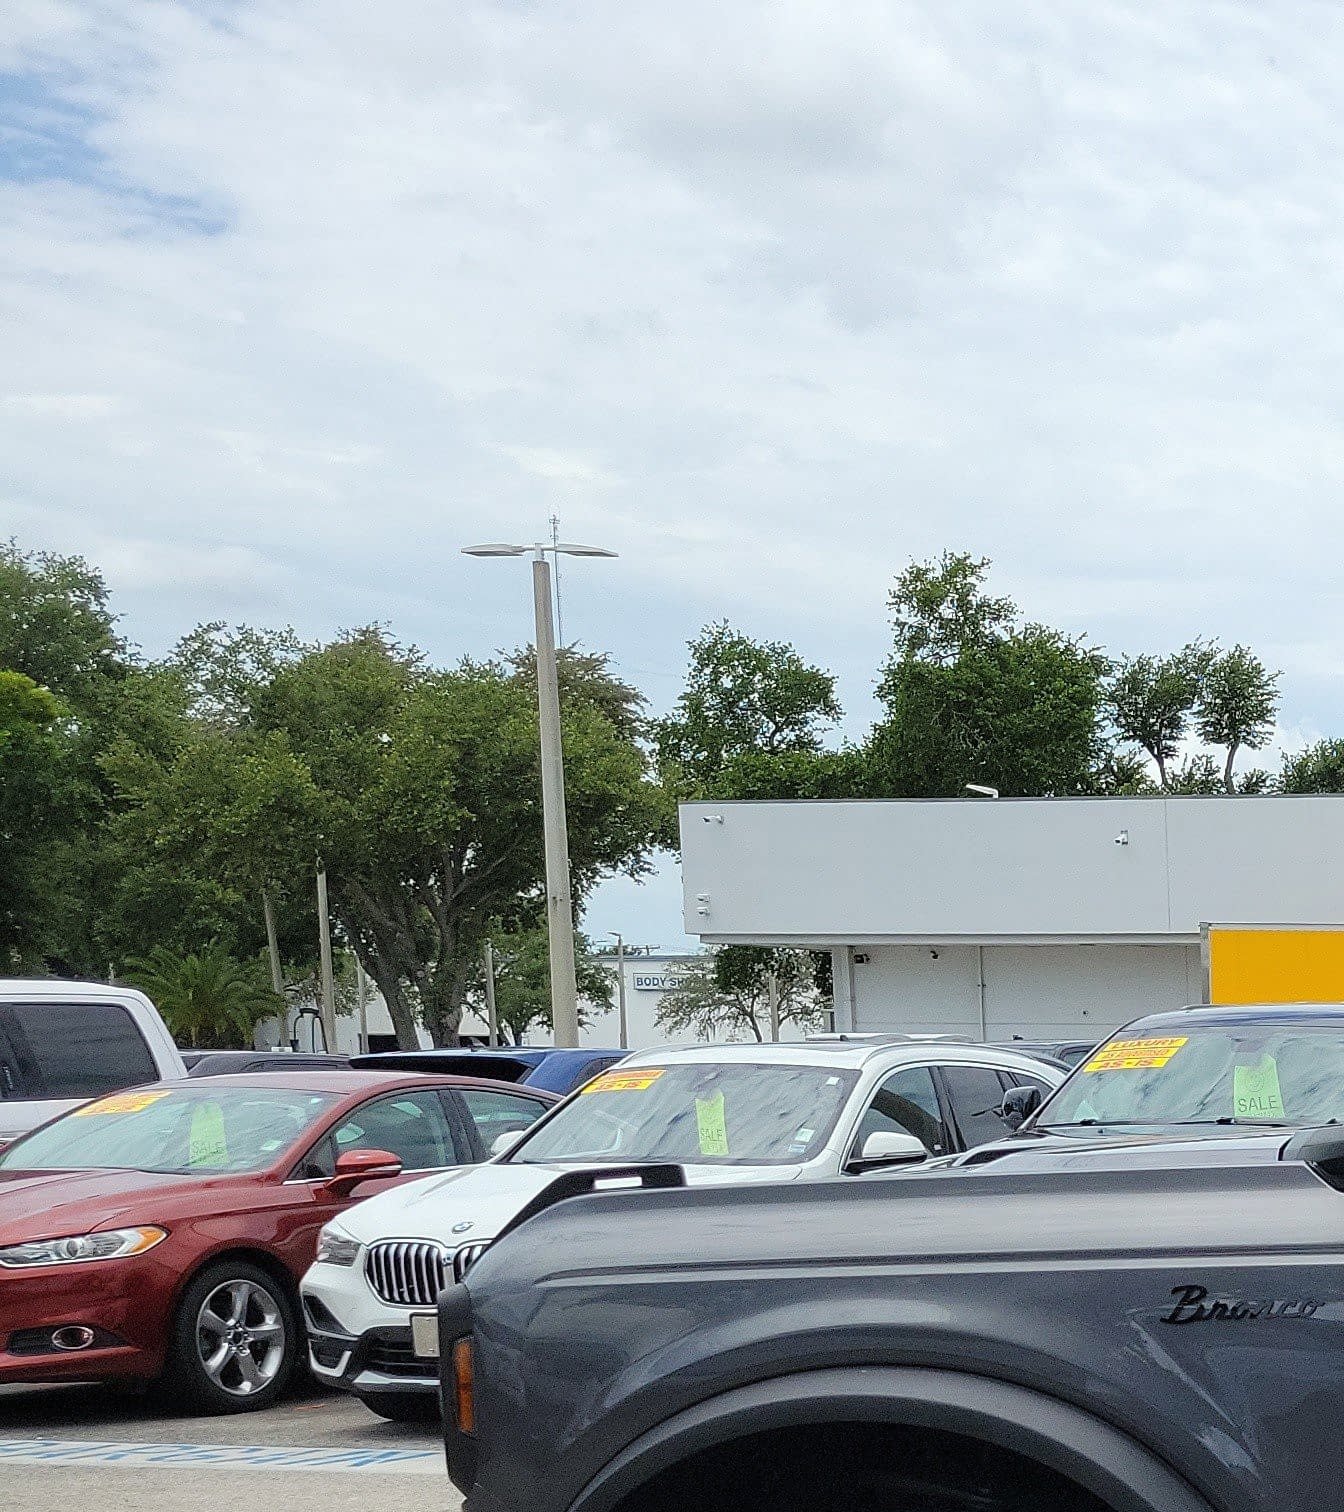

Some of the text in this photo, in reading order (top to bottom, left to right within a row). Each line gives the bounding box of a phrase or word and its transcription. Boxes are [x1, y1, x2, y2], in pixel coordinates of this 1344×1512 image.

[636, 977, 667, 987] BODY
[1113, 1038, 1182, 1049] LUXURY
[1238, 1095, 1279, 1113] SALE
[700, 1127, 724, 1142] SALE
[192, 1141, 223, 1155] SALE
[1159, 1284, 1326, 1325] Bronco
